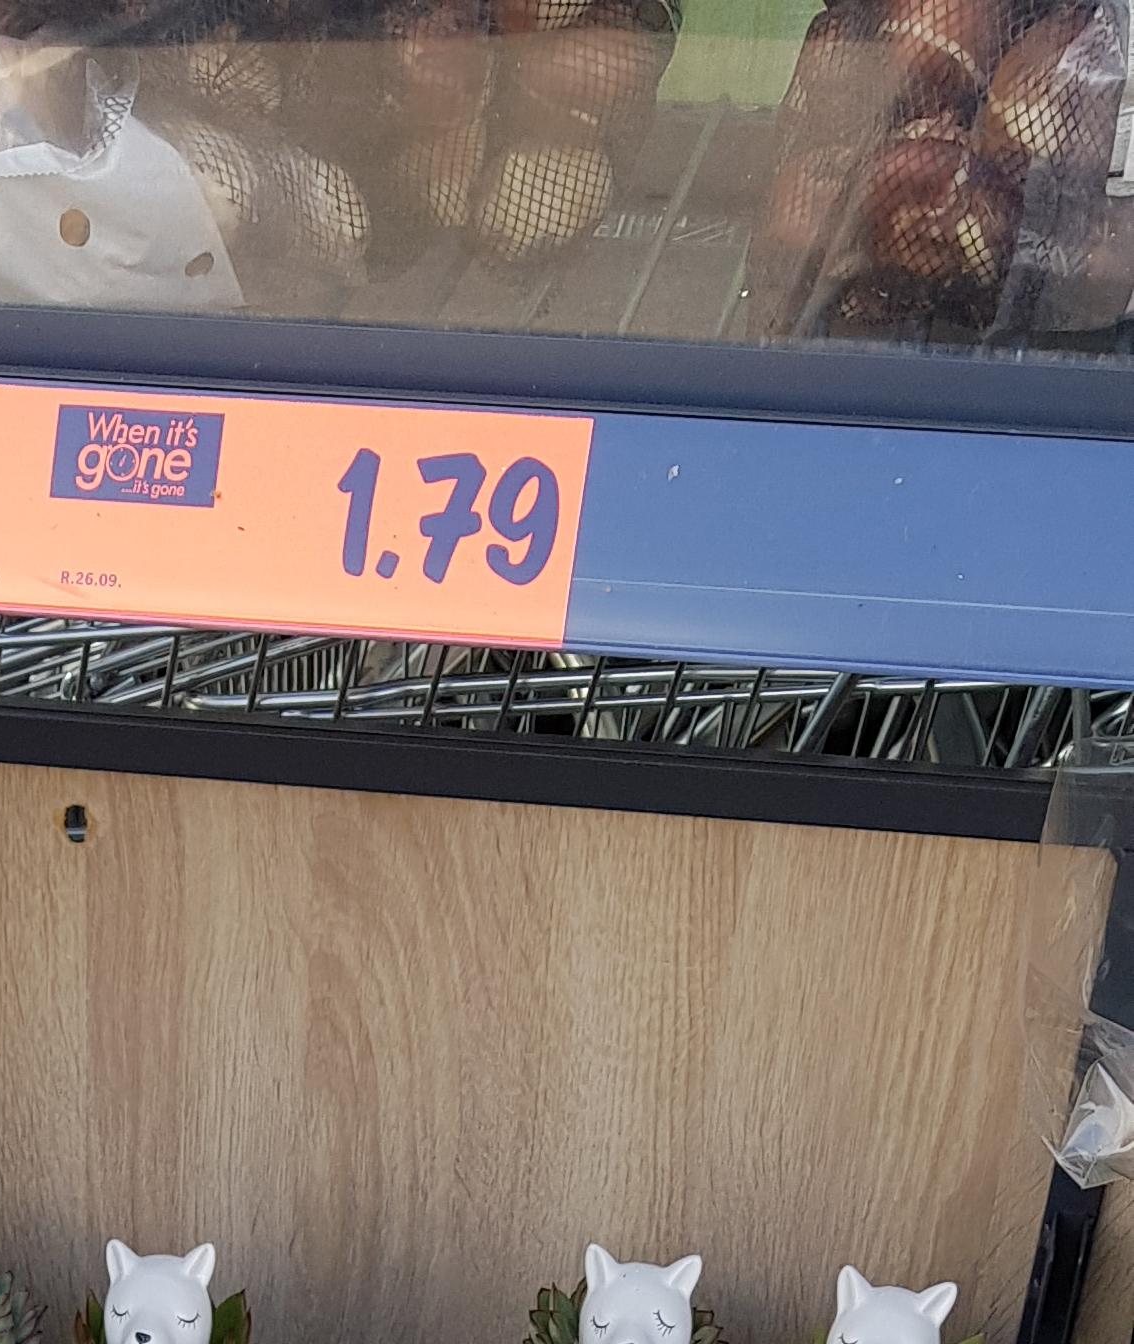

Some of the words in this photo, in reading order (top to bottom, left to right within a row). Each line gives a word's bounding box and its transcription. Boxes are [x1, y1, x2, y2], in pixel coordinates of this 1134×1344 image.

[87, 411, 161, 445] When
[166, 417, 199, 448] it's
[74, 442, 193, 491] gone
[150, 482, 185, 499] gone
[337, 447, 560, 585] 1.79
[61, 571, 122, 589] R.26.09.
